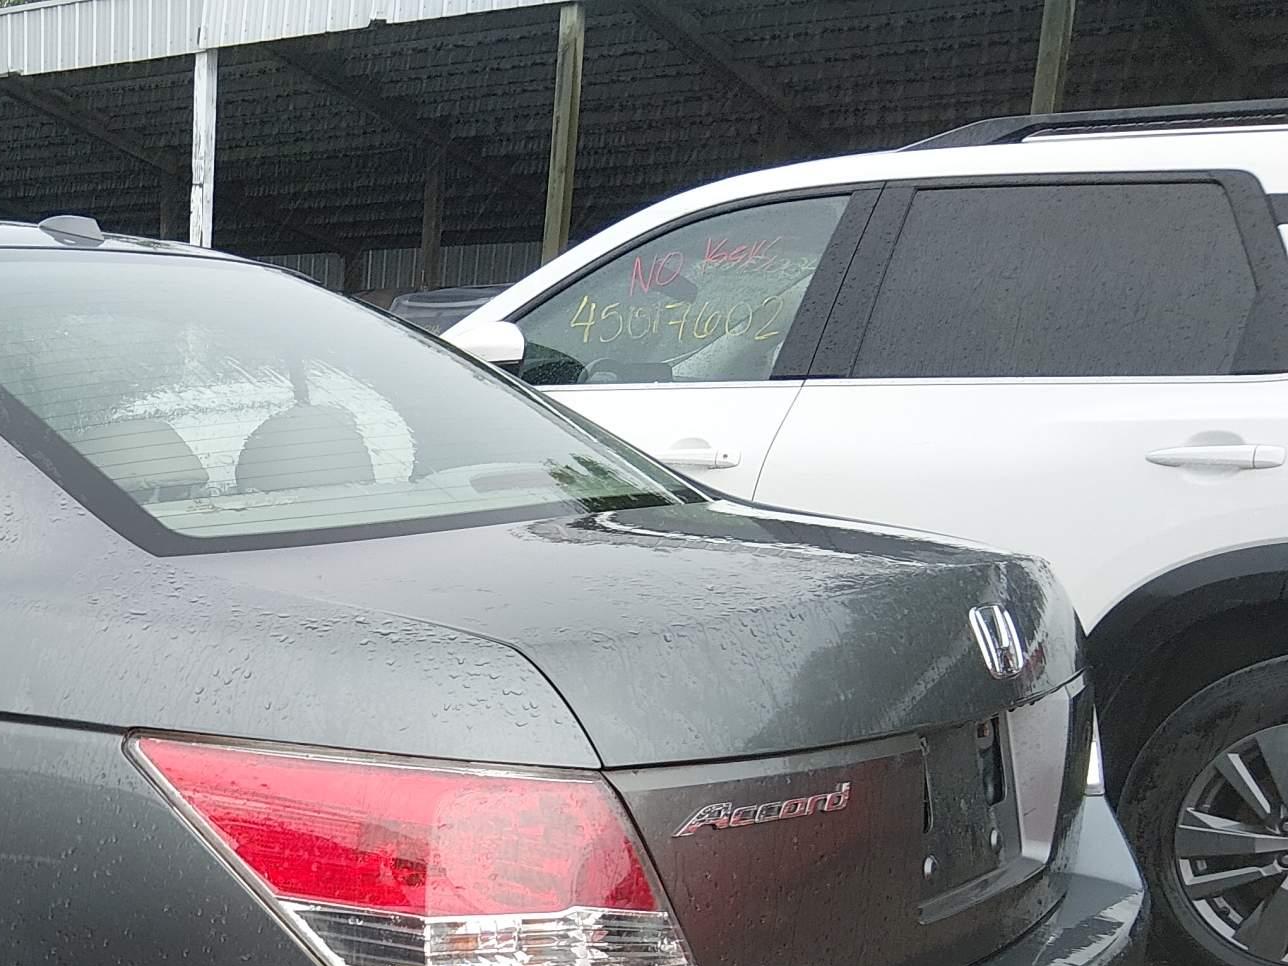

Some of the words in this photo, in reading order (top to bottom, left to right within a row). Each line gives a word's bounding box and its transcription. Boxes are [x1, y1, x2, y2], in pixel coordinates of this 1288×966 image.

[629, 251, 685, 297] NO
[570, 295, 786, 343] 45017602
[671, 782, 851, 838] Accord
